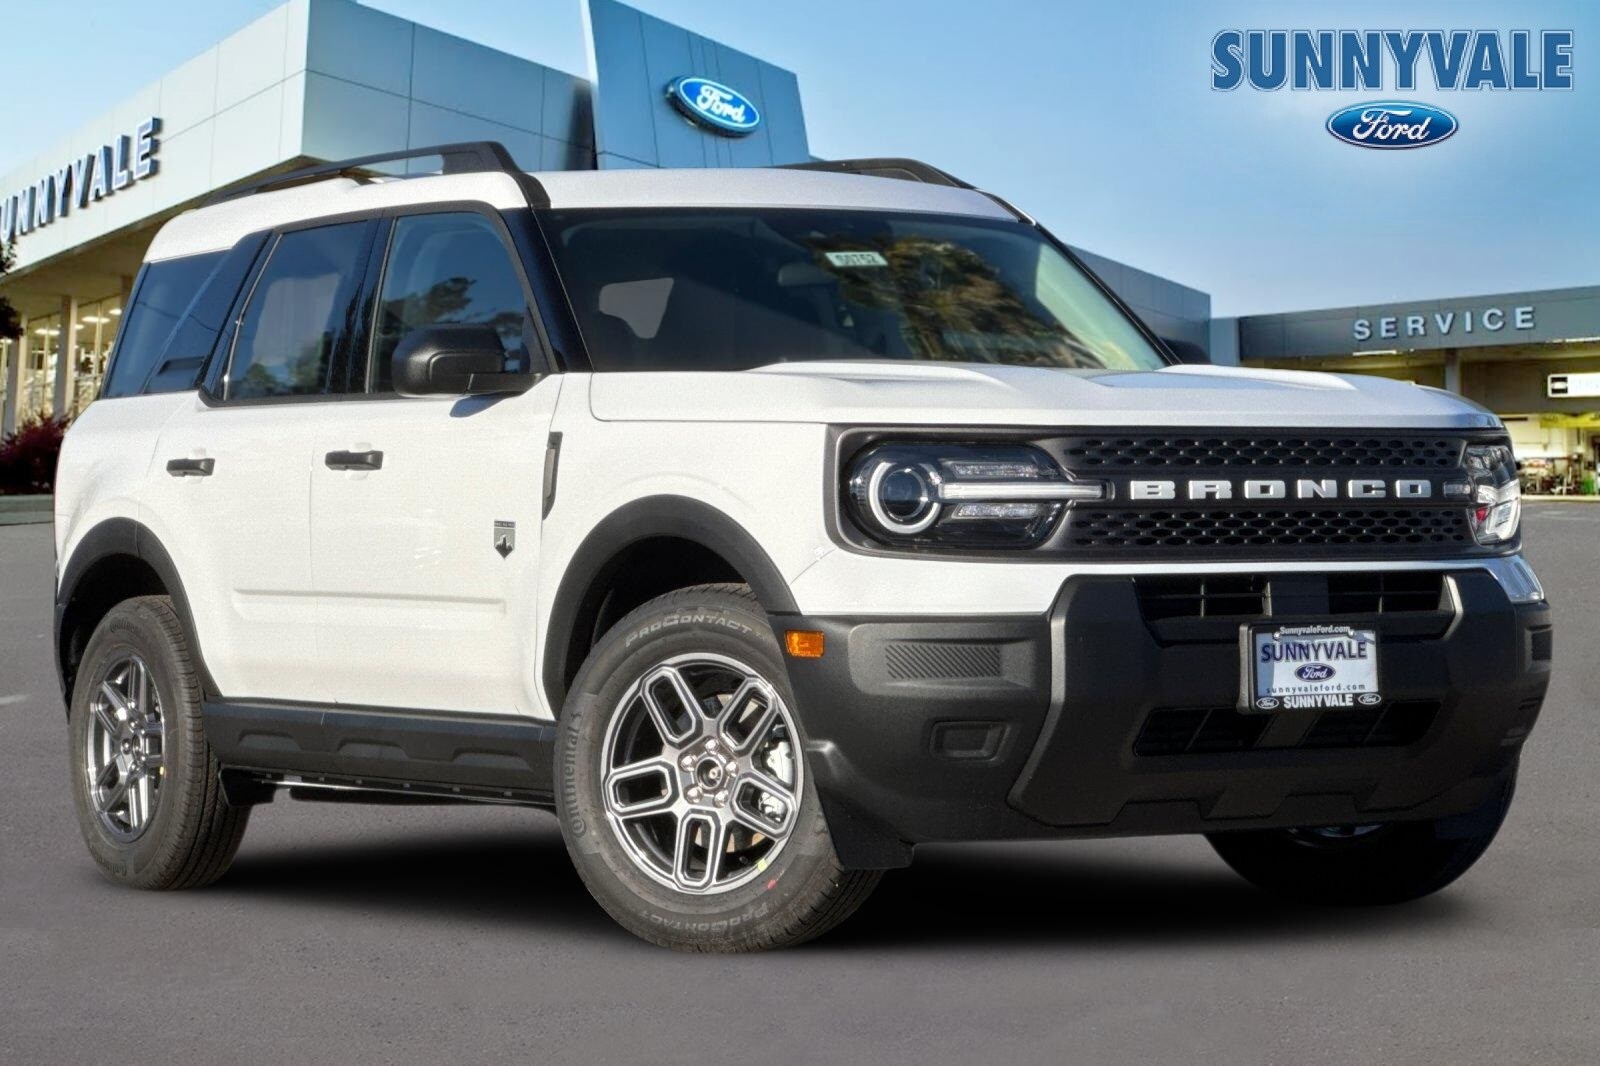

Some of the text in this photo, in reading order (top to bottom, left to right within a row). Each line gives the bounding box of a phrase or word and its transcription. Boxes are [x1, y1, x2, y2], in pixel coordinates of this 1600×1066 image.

[696, 85, 746, 123] Ford
[0, 117, 162, 244] UNNYVALE
[1353, 306, 1535, 341] SERVICE
[1130, 479, 1432, 500] BRONCO
[1261, 641, 1367, 663] SUNNYVALE
[1302, 665, 1328, 679] Ford
[1266, 684, 1366, 693] sunnyvaleford.com
[1283, 694, 1354, 709] SUNNYVALE
